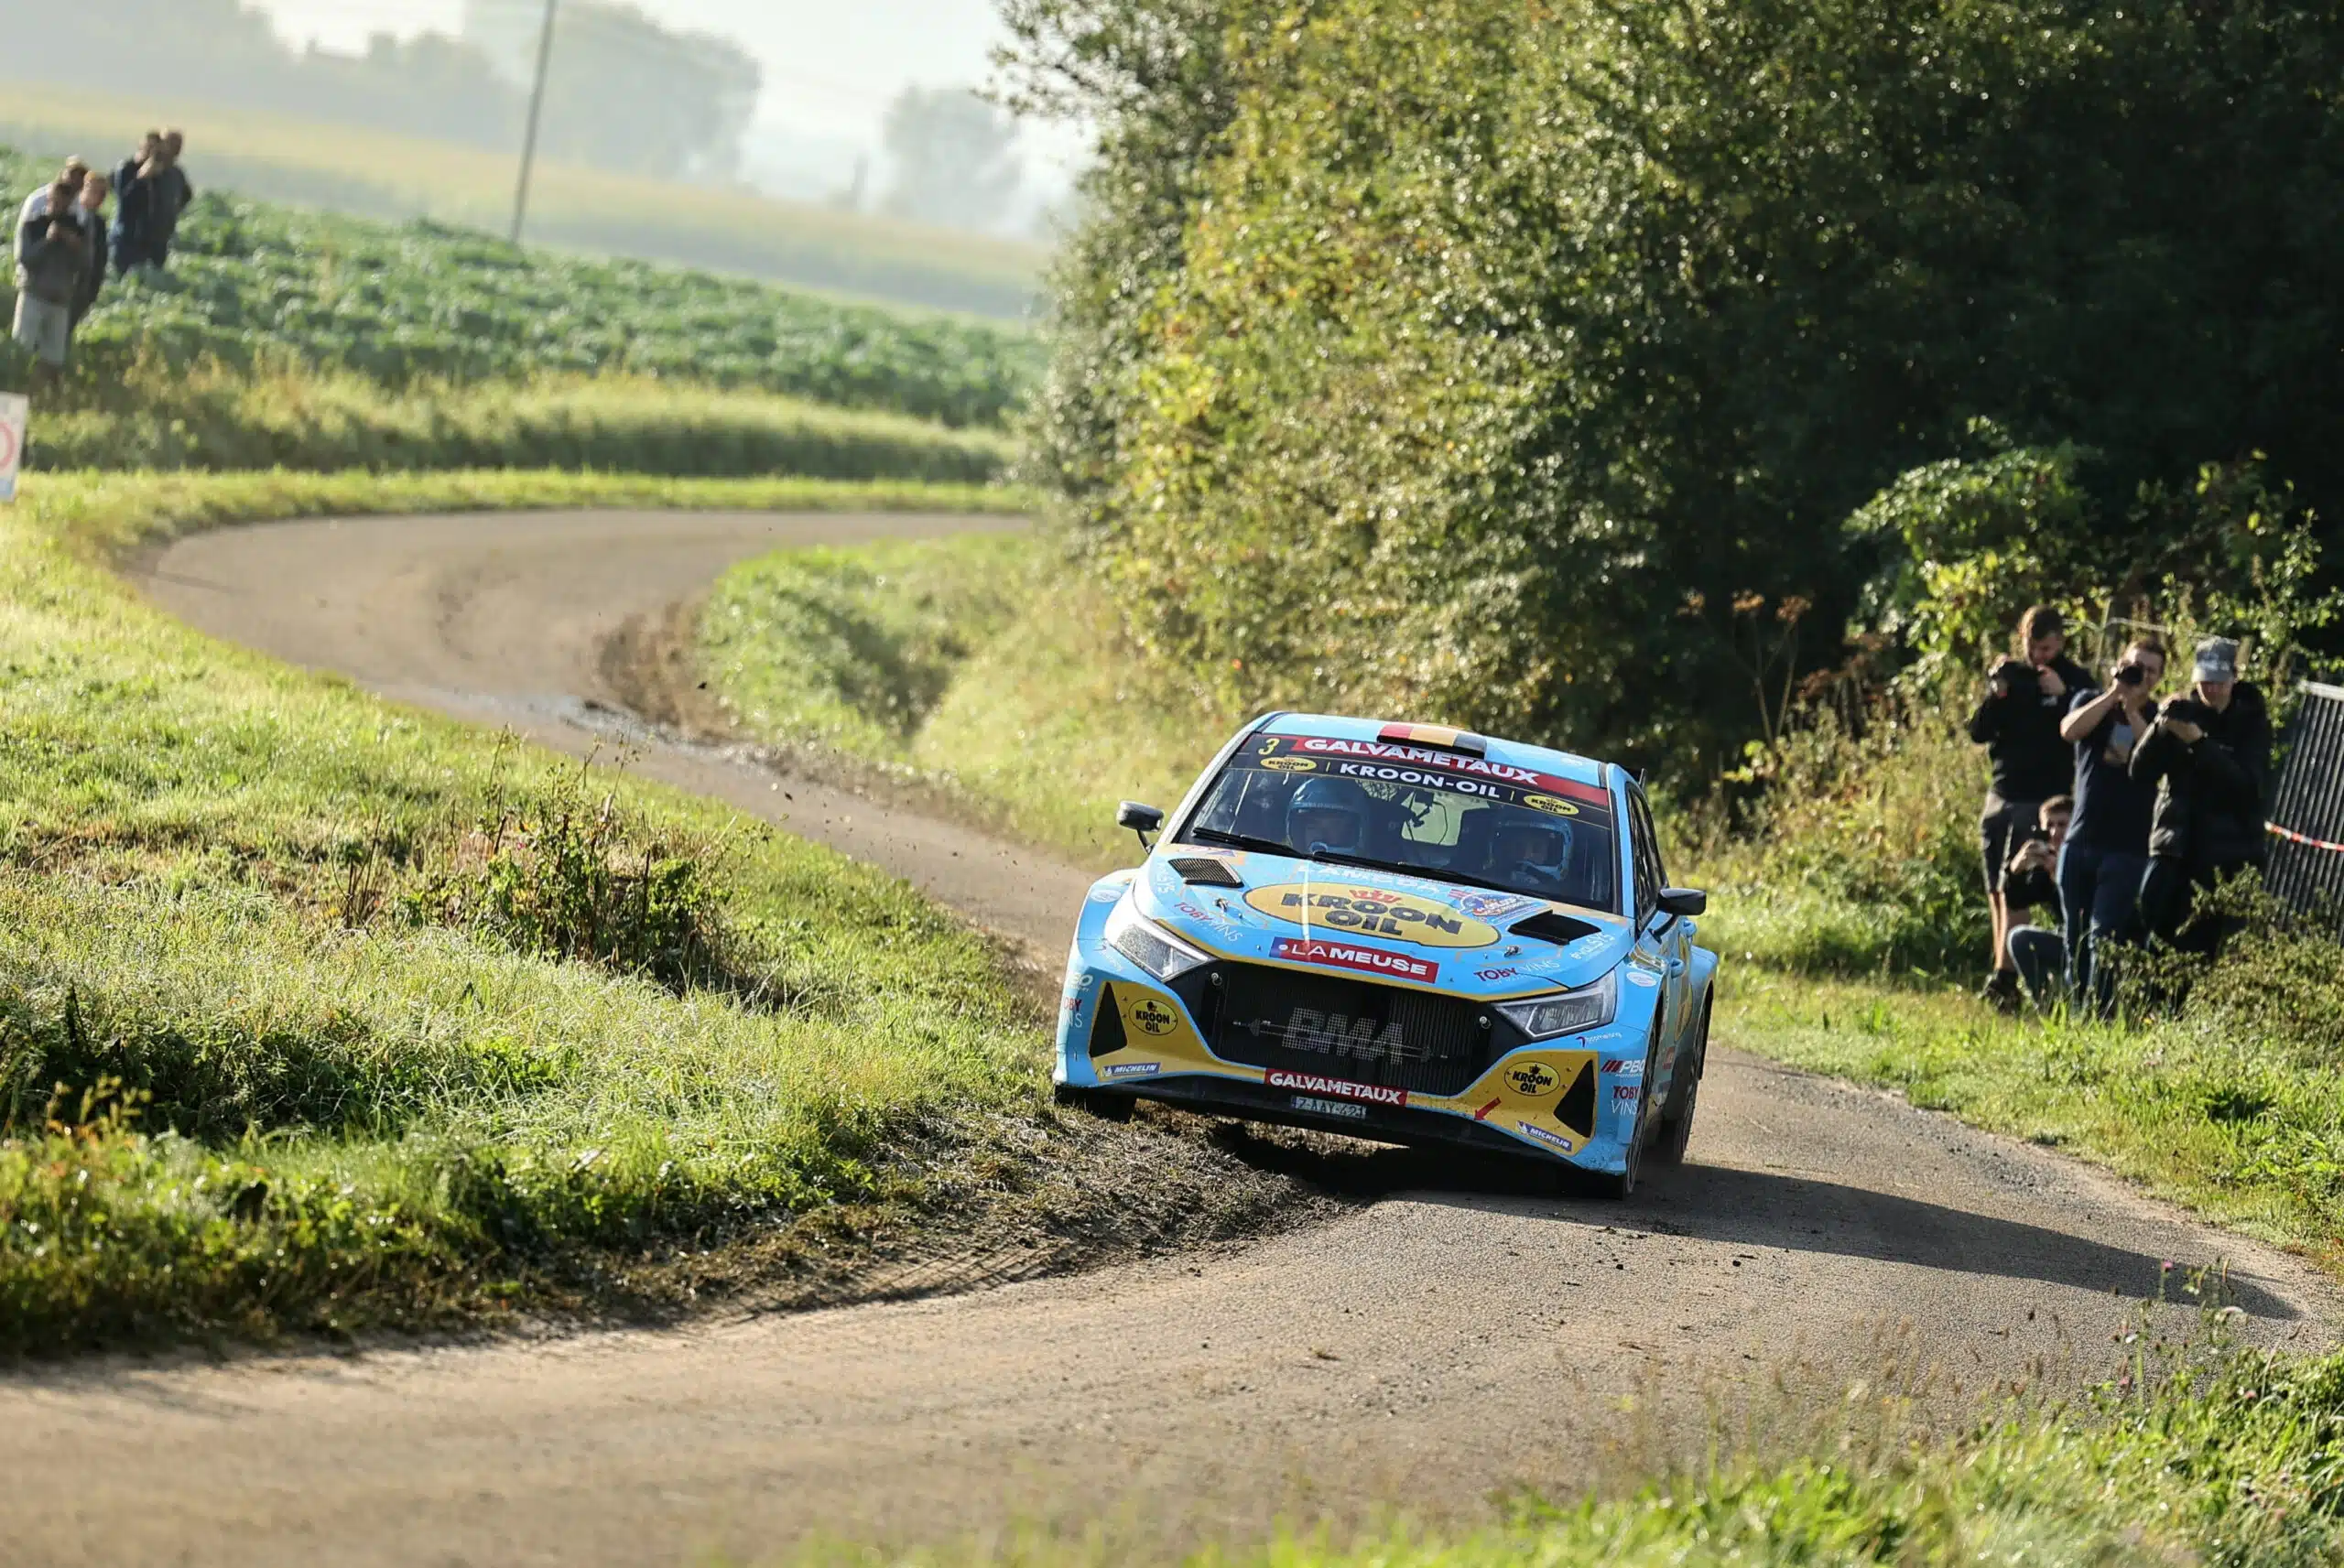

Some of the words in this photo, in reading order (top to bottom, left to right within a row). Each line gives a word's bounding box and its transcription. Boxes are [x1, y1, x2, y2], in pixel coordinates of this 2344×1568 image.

[1258, 738, 1280, 755] 3
[1304, 739, 1540, 785] GALVAMETAUX
[1340, 762, 1501, 799] KROON-OIL
[1531, 798, 1571, 812] KROON
[1281, 892, 1463, 935] KROON
[1325, 909, 1404, 936] OIL
[1473, 967, 1518, 983] TOBY
[1135, 1010, 1171, 1024] KROON
[1145, 1021, 1161, 1033] OIL
[1113, 1064, 1157, 1074] MICHELIN
[1512, 1071, 1553, 1087] KROON
[1269, 1072, 1402, 1106] GALVAMETAUX
[1520, 1081, 1537, 1094] OIL
[1612, 1085, 1640, 1099] TOBY
[1611, 1099, 1637, 1116] VINS
[1530, 1128, 1570, 1149] MICHELIN
